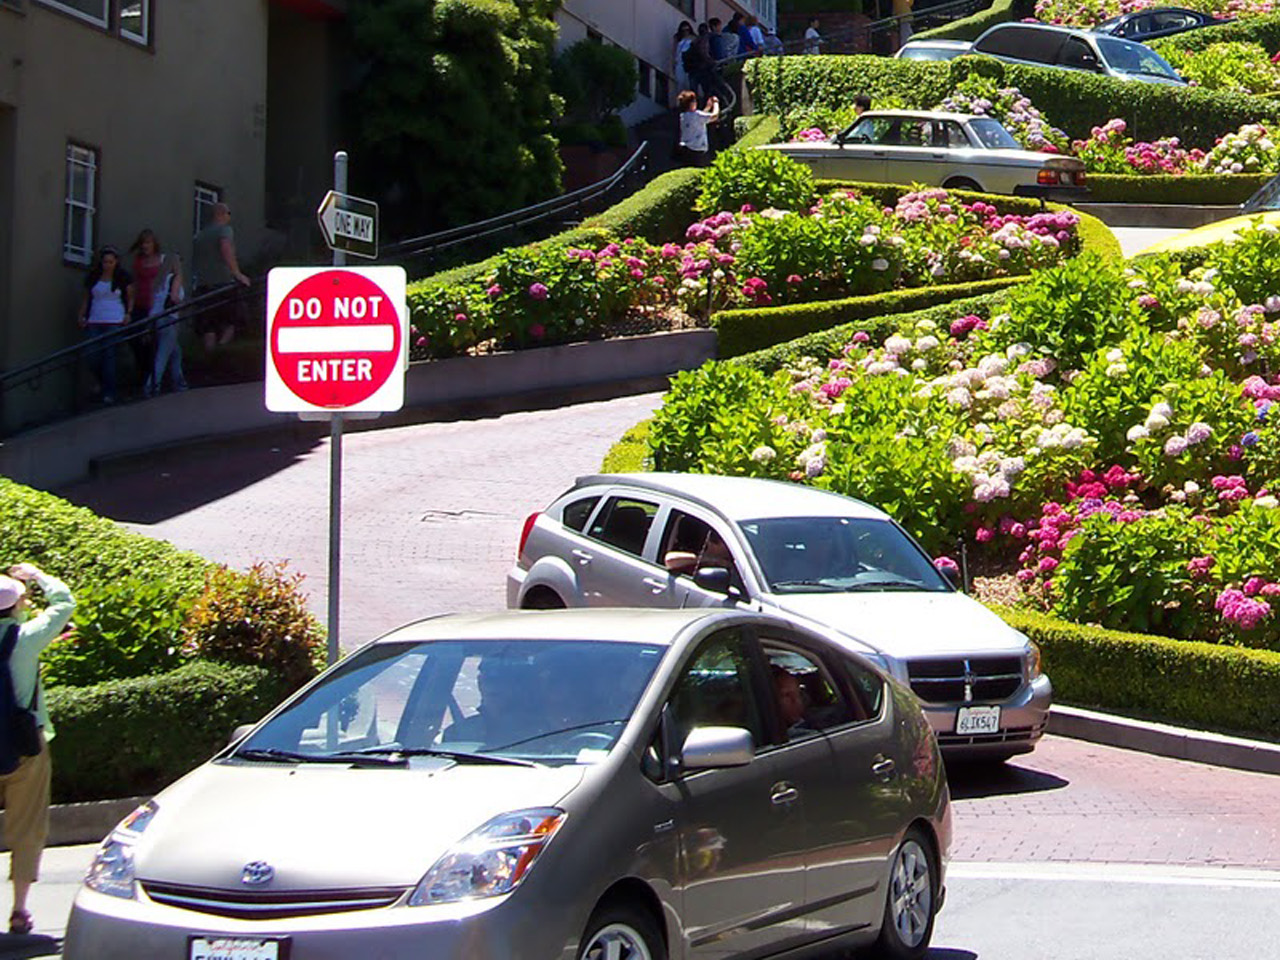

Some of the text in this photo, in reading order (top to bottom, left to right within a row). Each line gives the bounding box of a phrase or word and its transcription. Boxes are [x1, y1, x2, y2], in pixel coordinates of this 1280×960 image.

[335, 211, 372, 239] ONE WAY
[288, 296, 383, 320] DO NOT
[297, 358, 373, 382] ENTER
